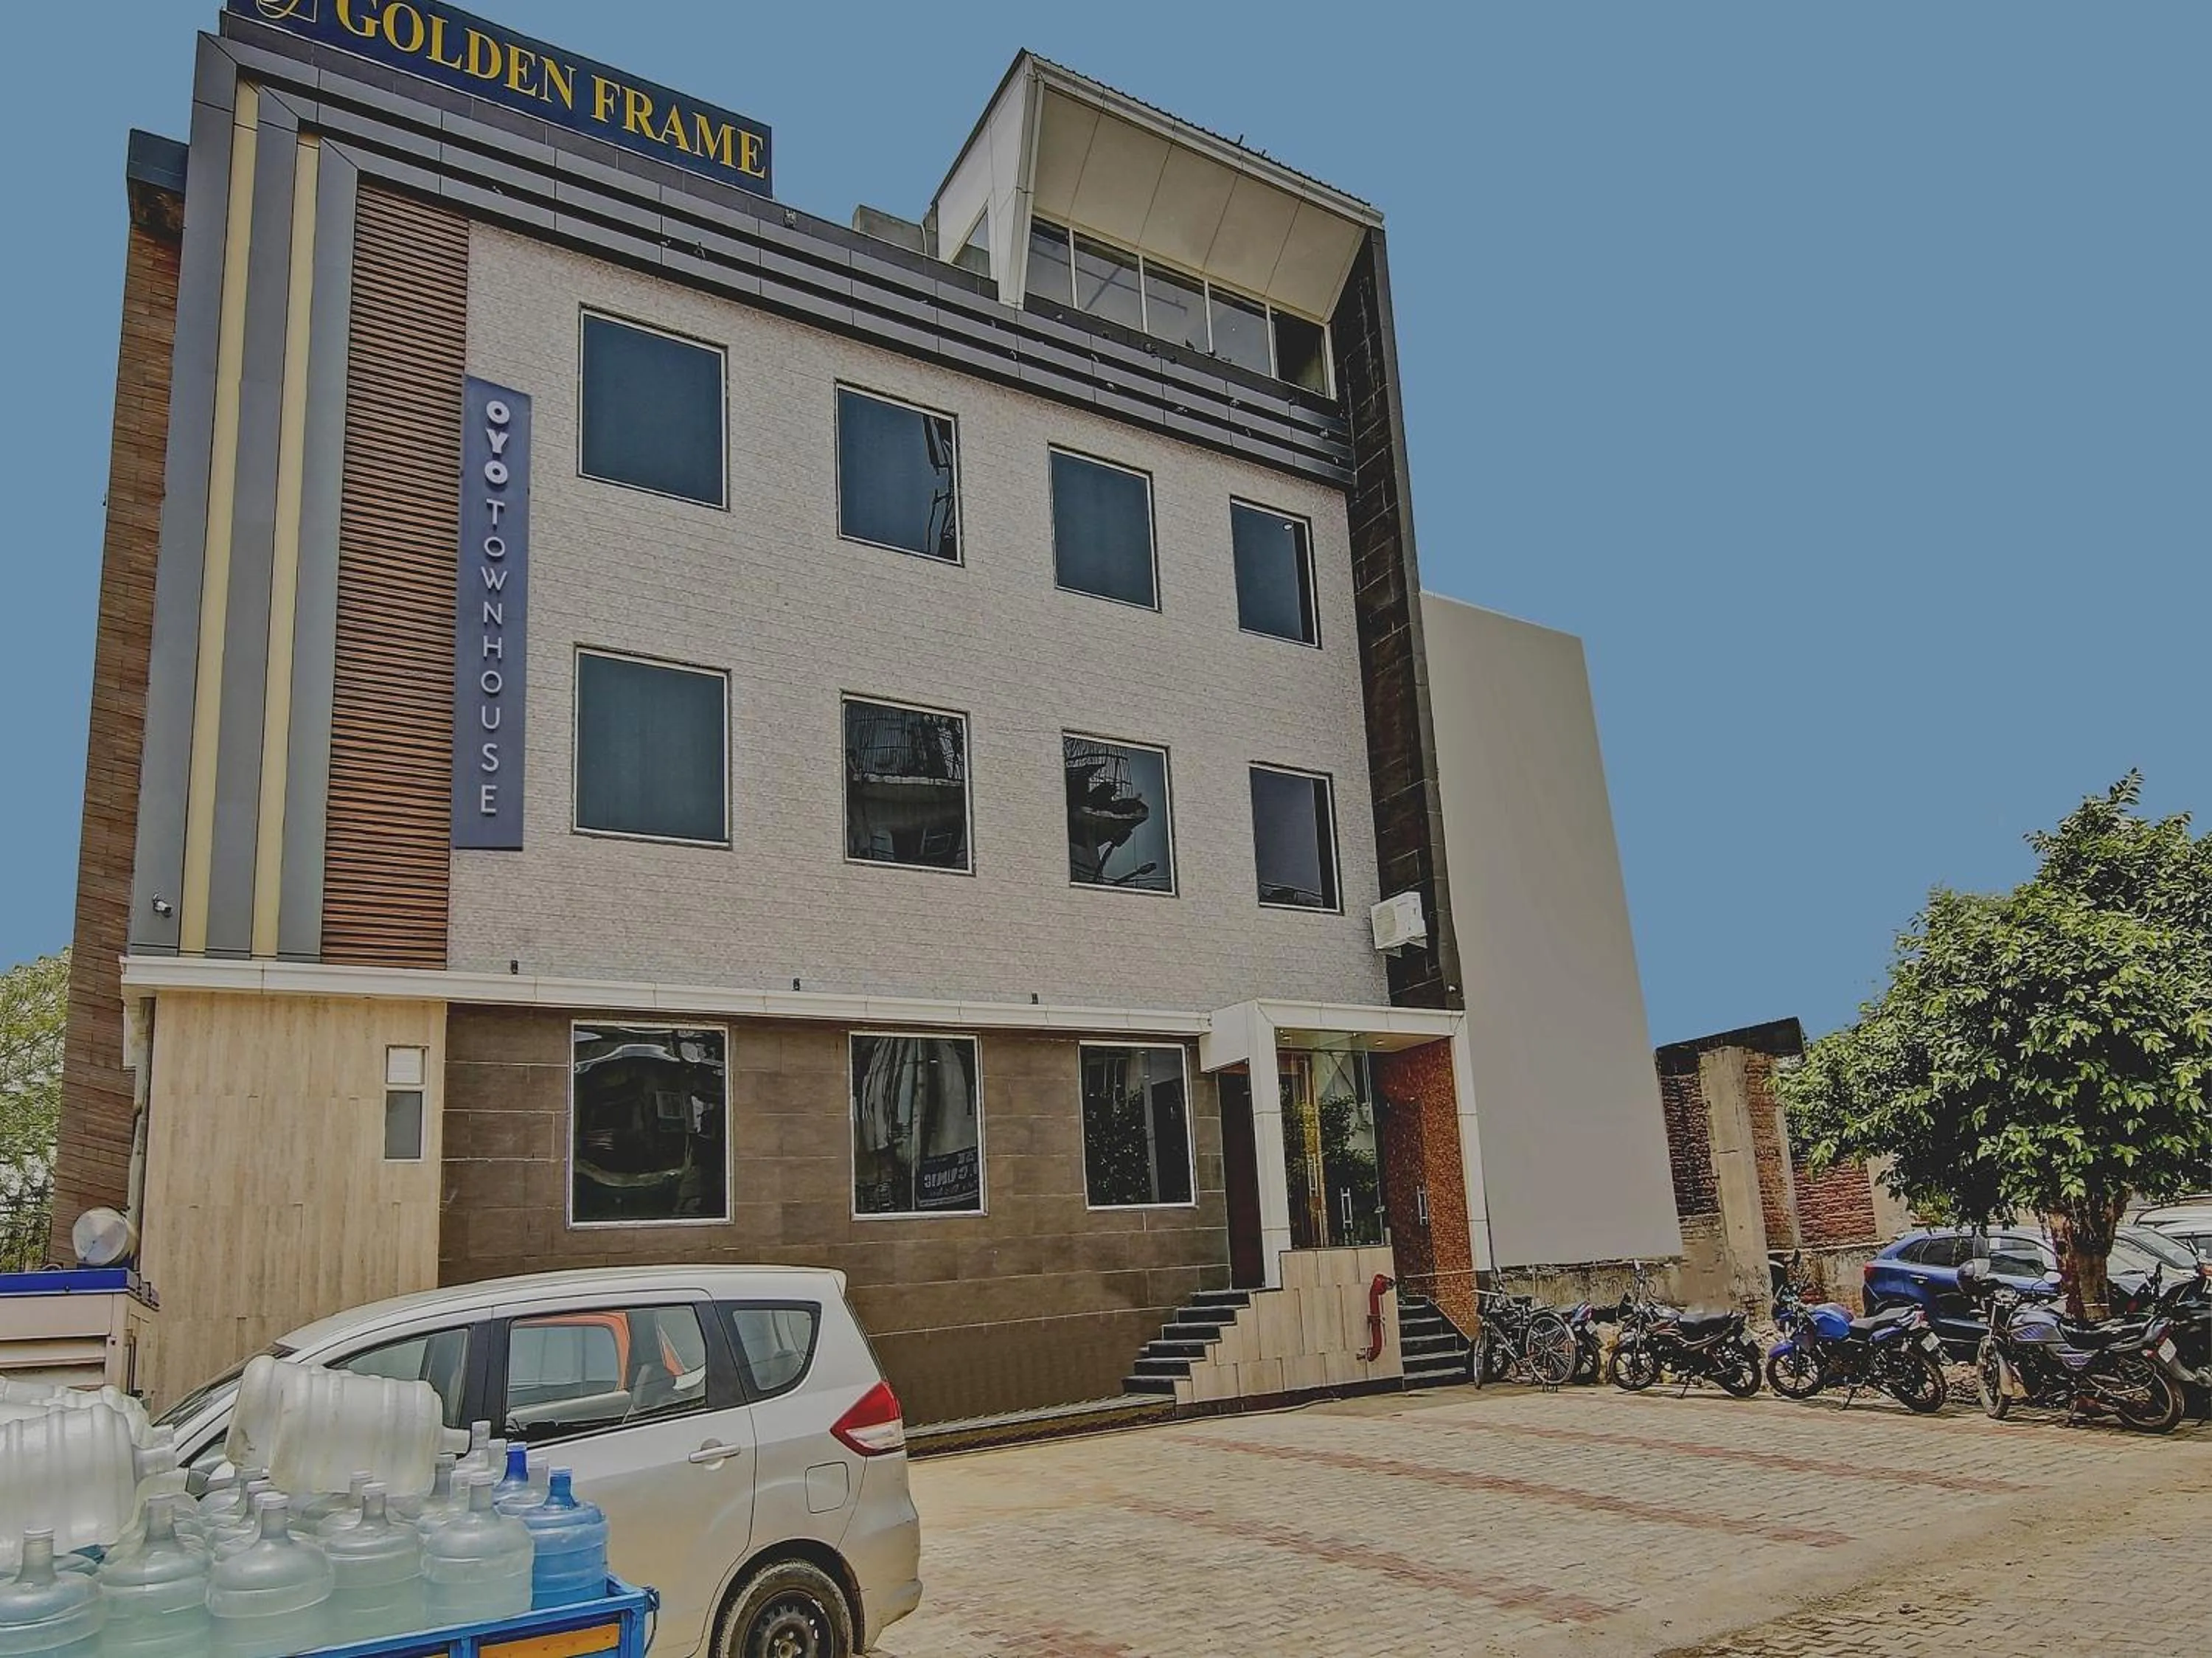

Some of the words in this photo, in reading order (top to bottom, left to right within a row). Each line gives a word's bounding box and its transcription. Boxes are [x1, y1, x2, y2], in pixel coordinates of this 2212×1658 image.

[336, 0, 577, 110] GOLDEN
[591, 74, 766, 178] FRAME
[484, 400, 510, 485] OYO
[480, 498, 507, 814] TOWNHOUSE
